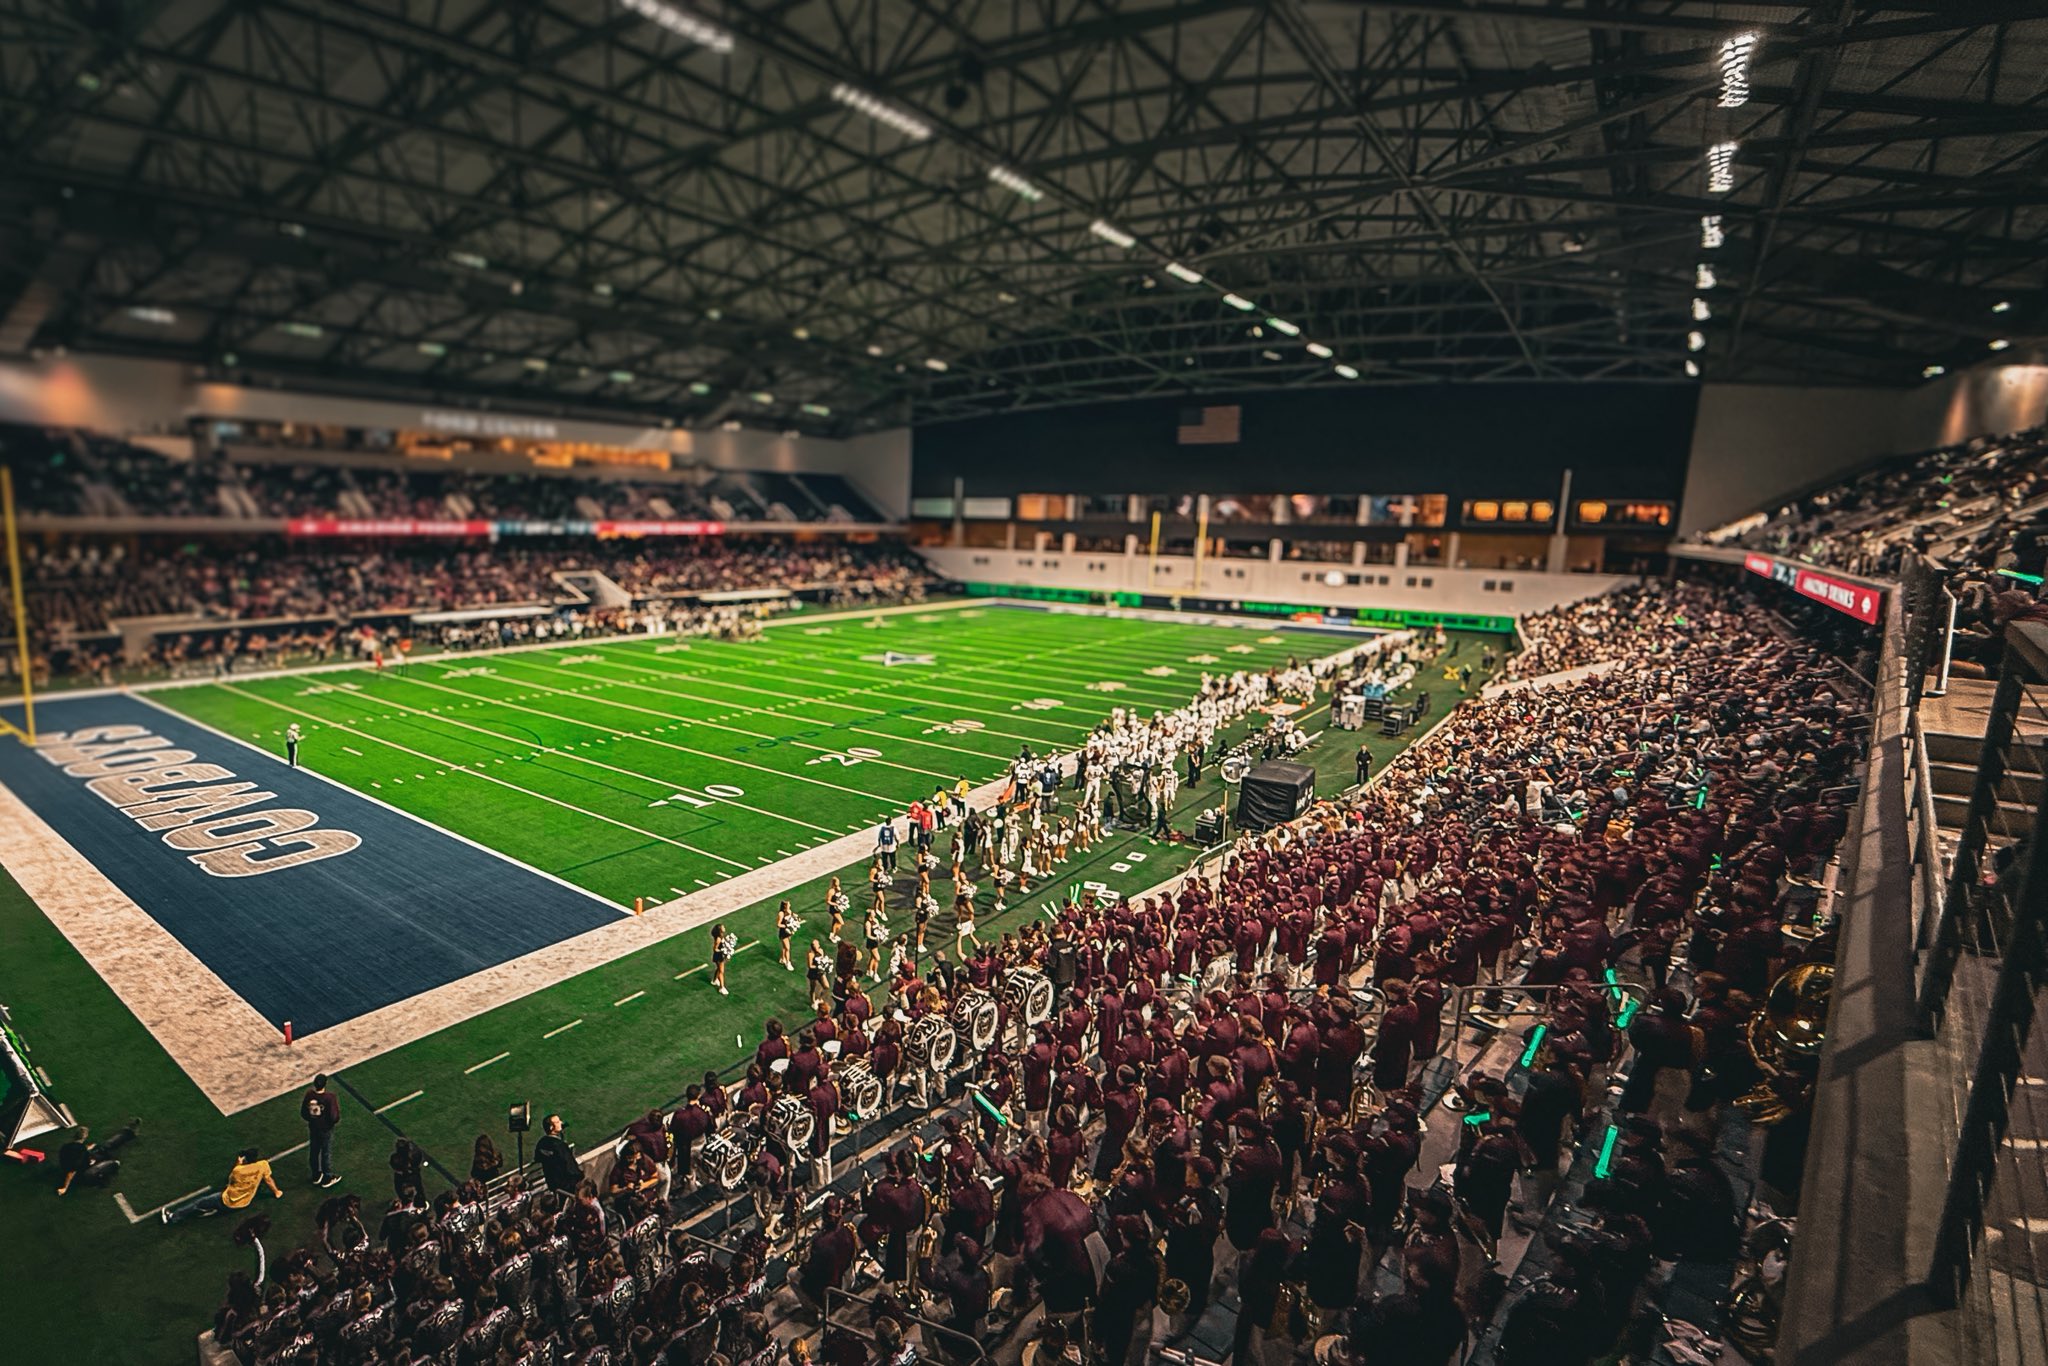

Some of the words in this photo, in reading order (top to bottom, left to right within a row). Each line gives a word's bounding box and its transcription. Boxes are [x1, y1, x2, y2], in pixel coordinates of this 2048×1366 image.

[932, 719, 985, 734] 30
[735, 731, 820, 753] FORD
[819, 747, 883, 766] 20
[34, 724, 363, 878] COWBOYS
[667, 784, 744, 808] 10
